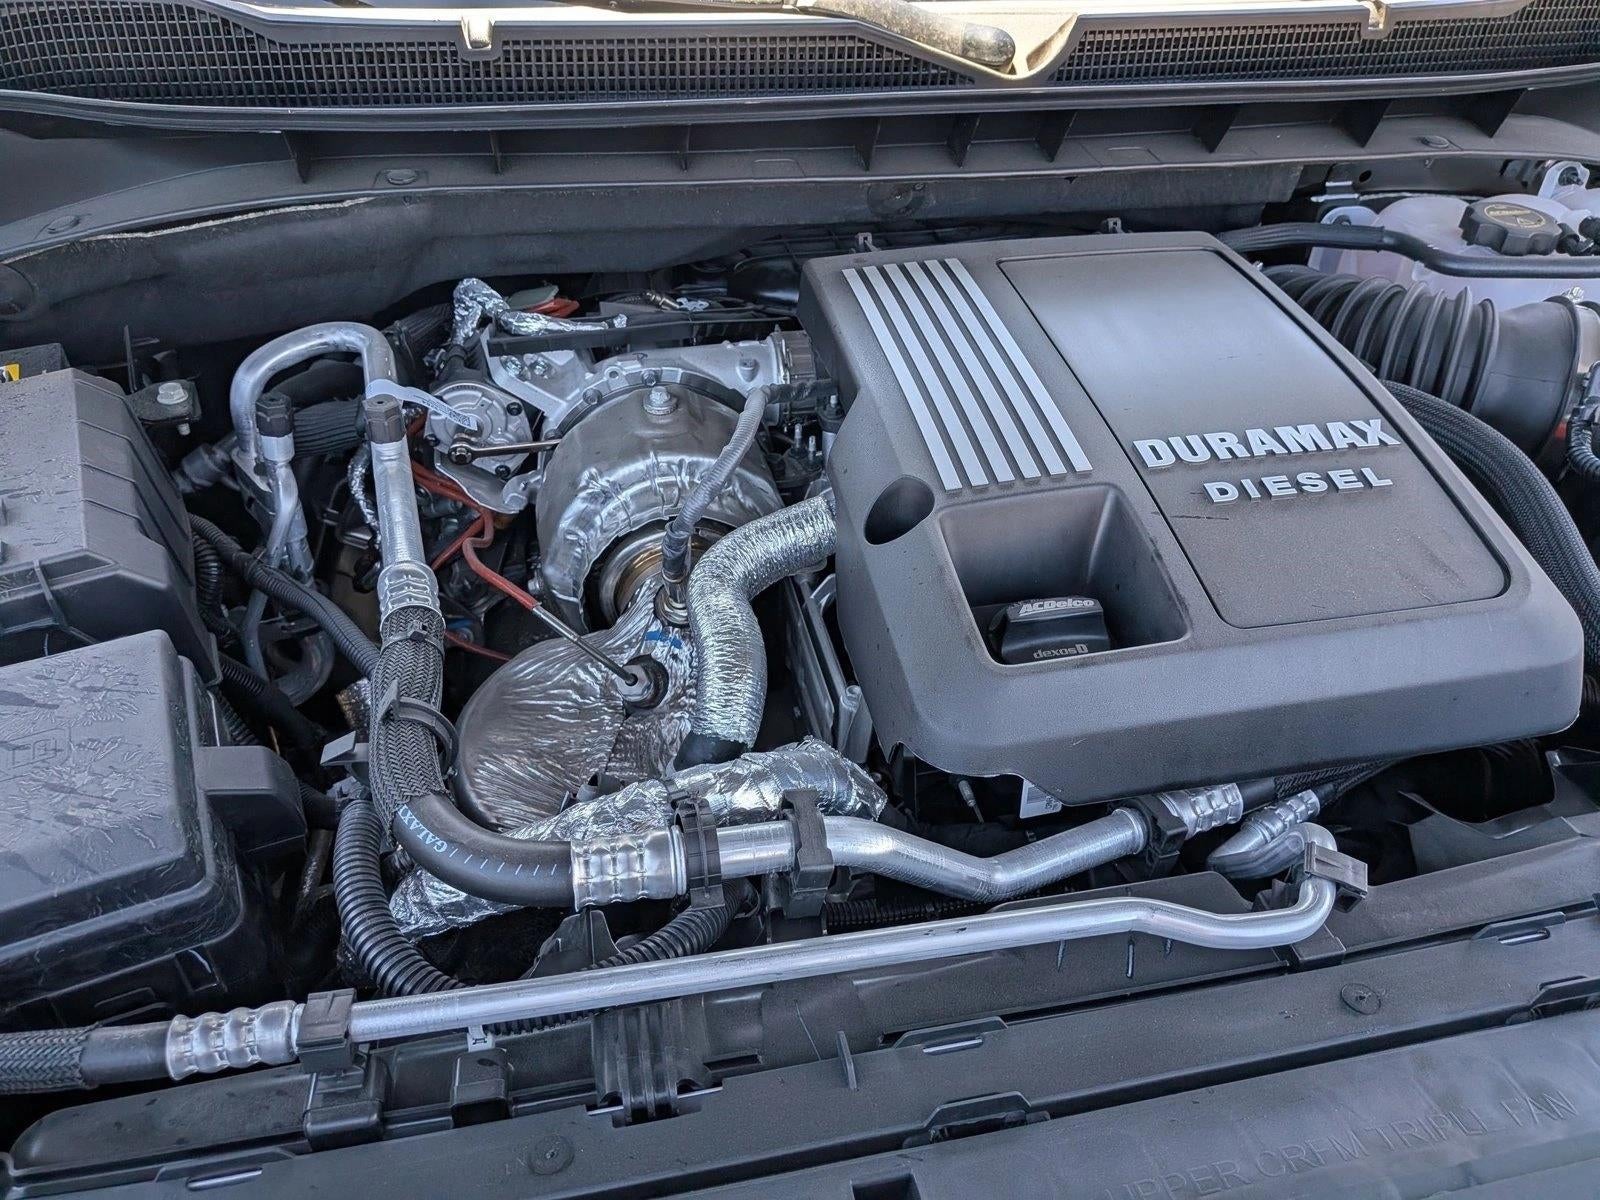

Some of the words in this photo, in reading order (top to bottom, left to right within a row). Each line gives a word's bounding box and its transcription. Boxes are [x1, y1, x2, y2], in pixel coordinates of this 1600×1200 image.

[1132, 418, 1401, 468] DURAMAX
[1203, 467, 1394, 503] DIESEL
[1019, 599, 1095, 617] ACDelco
